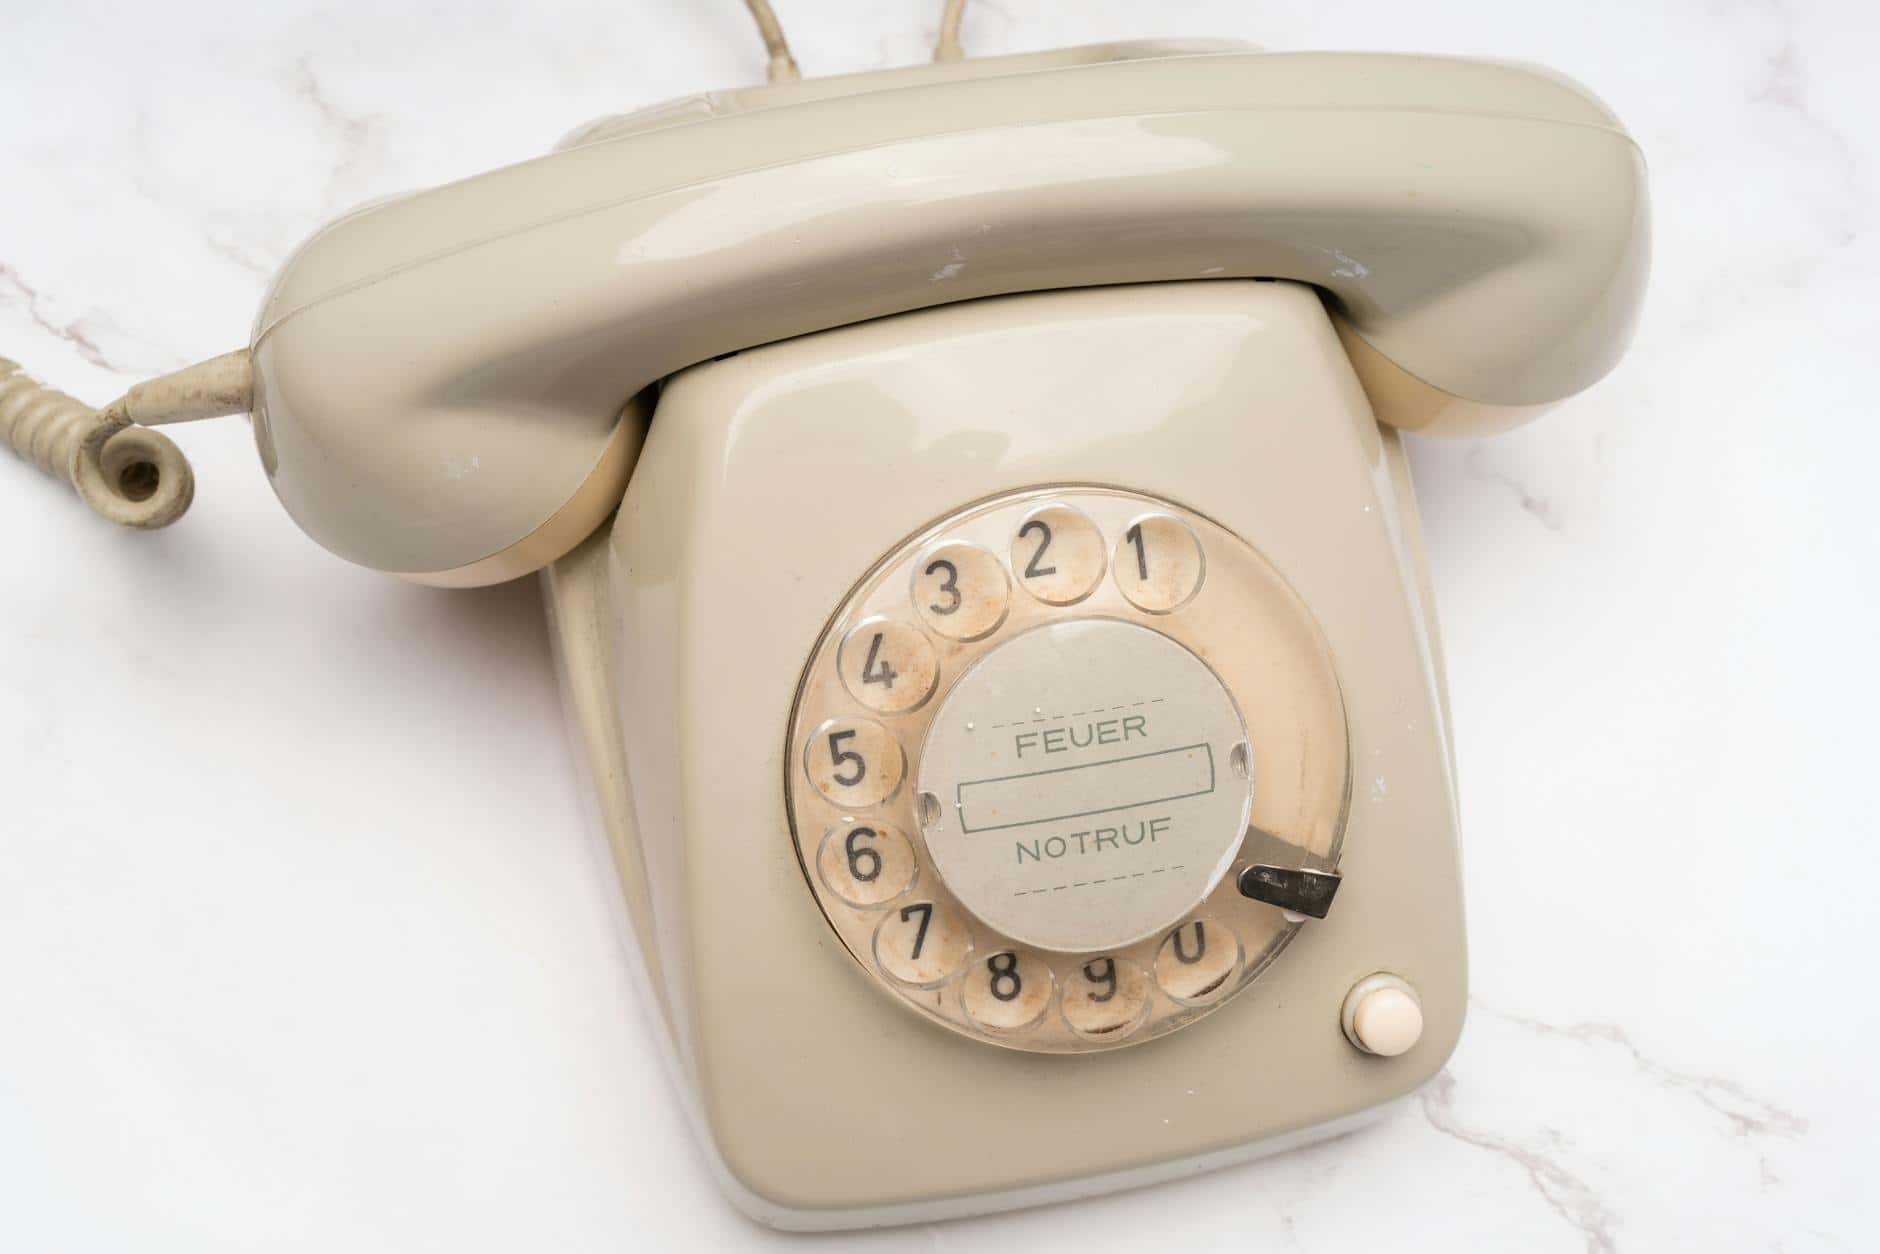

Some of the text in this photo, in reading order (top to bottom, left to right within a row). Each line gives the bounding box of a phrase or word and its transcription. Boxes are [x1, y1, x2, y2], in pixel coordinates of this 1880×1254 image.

[1018, 520, 1056, 579] 2
[1126, 523, 1148, 581] 1
[925, 559, 961, 615] 3
[862, 633, 898, 689] 4
[828, 729, 866, 786] 5
[1014, 715, 1148, 759] FEUER
[845, 827, 882, 882] 6
[1015, 817, 1172, 865] NOTRUF
[900, 903, 933, 960] 7
[986, 953, 1022, 1001] 8
[1084, 957, 1118, 1002] 9
